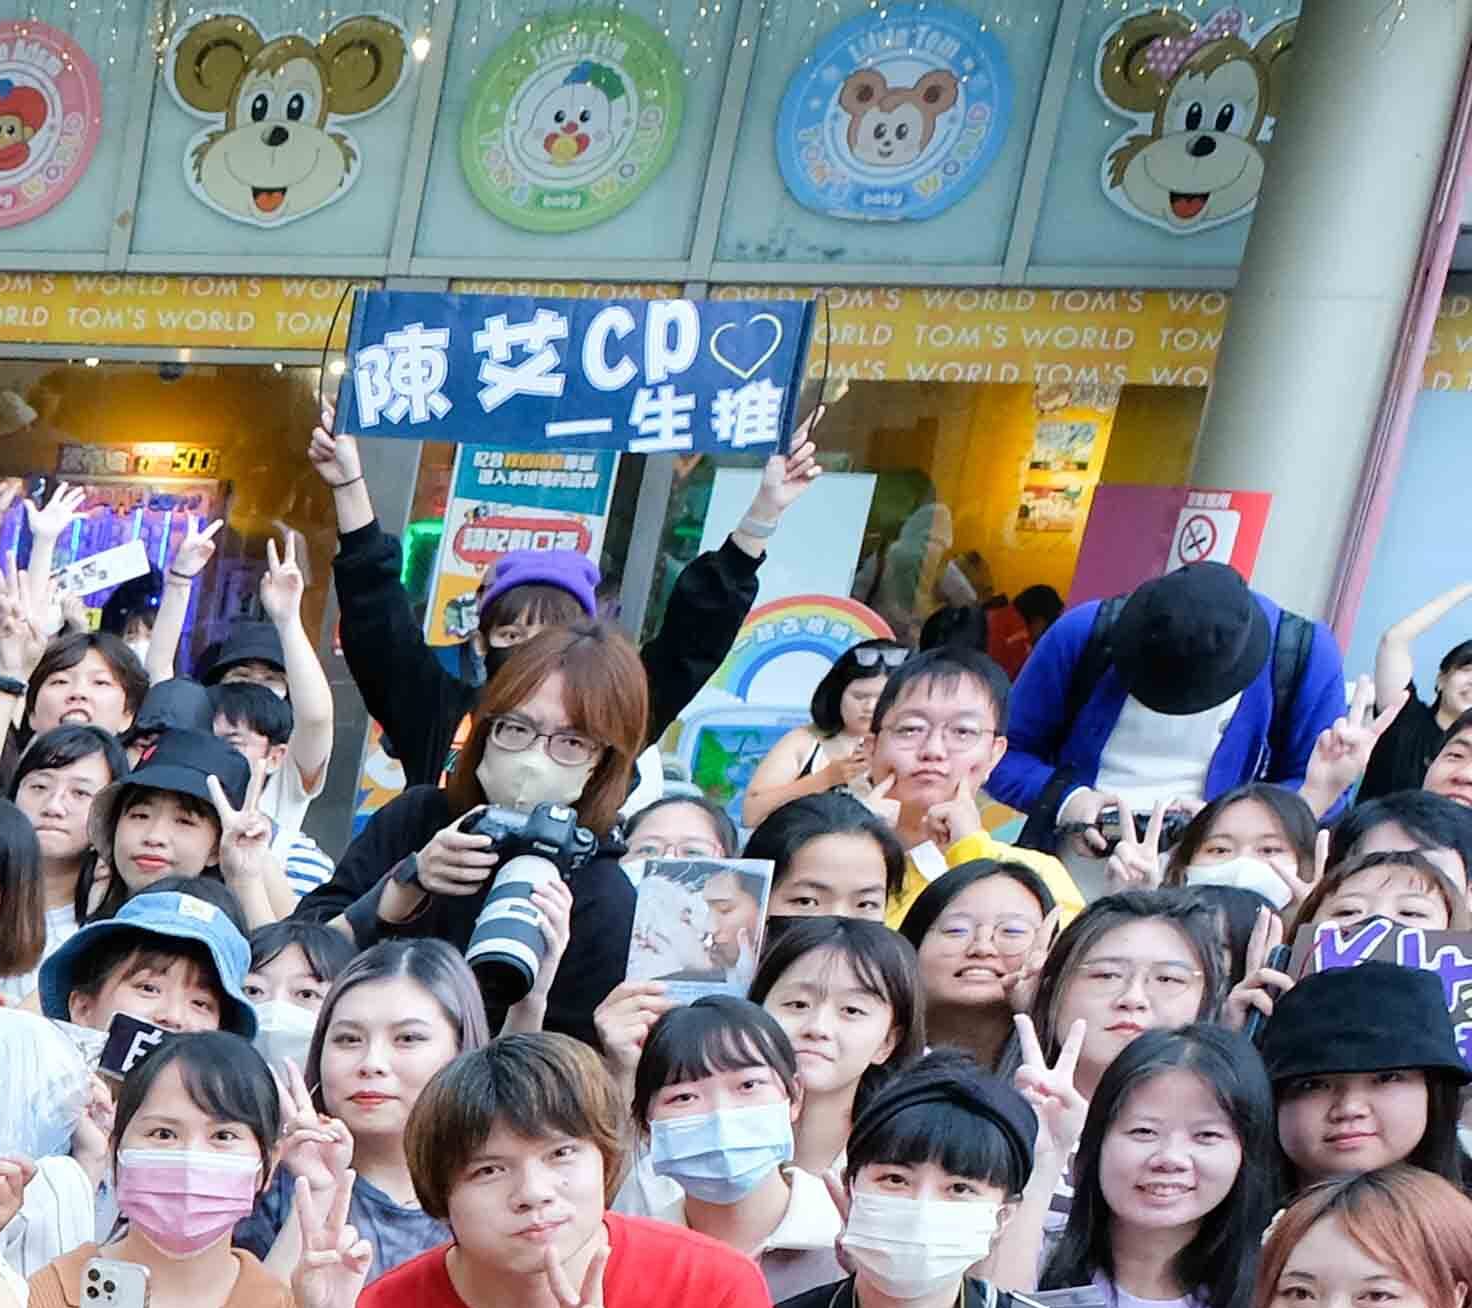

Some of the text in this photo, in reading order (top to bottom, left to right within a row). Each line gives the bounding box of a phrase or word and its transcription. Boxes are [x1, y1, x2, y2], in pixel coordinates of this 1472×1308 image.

[71, 275, 168, 297] WORLD
[922, 289, 1037, 312] WORLD
[1048, 290, 1145, 312] TOM'S
[66, 306, 146, 330] TOM'S
[158, 309, 256, 332] WORLD
[914, 325, 1008, 347] TOM'S
[1022, 326, 1136, 350] WORLD
